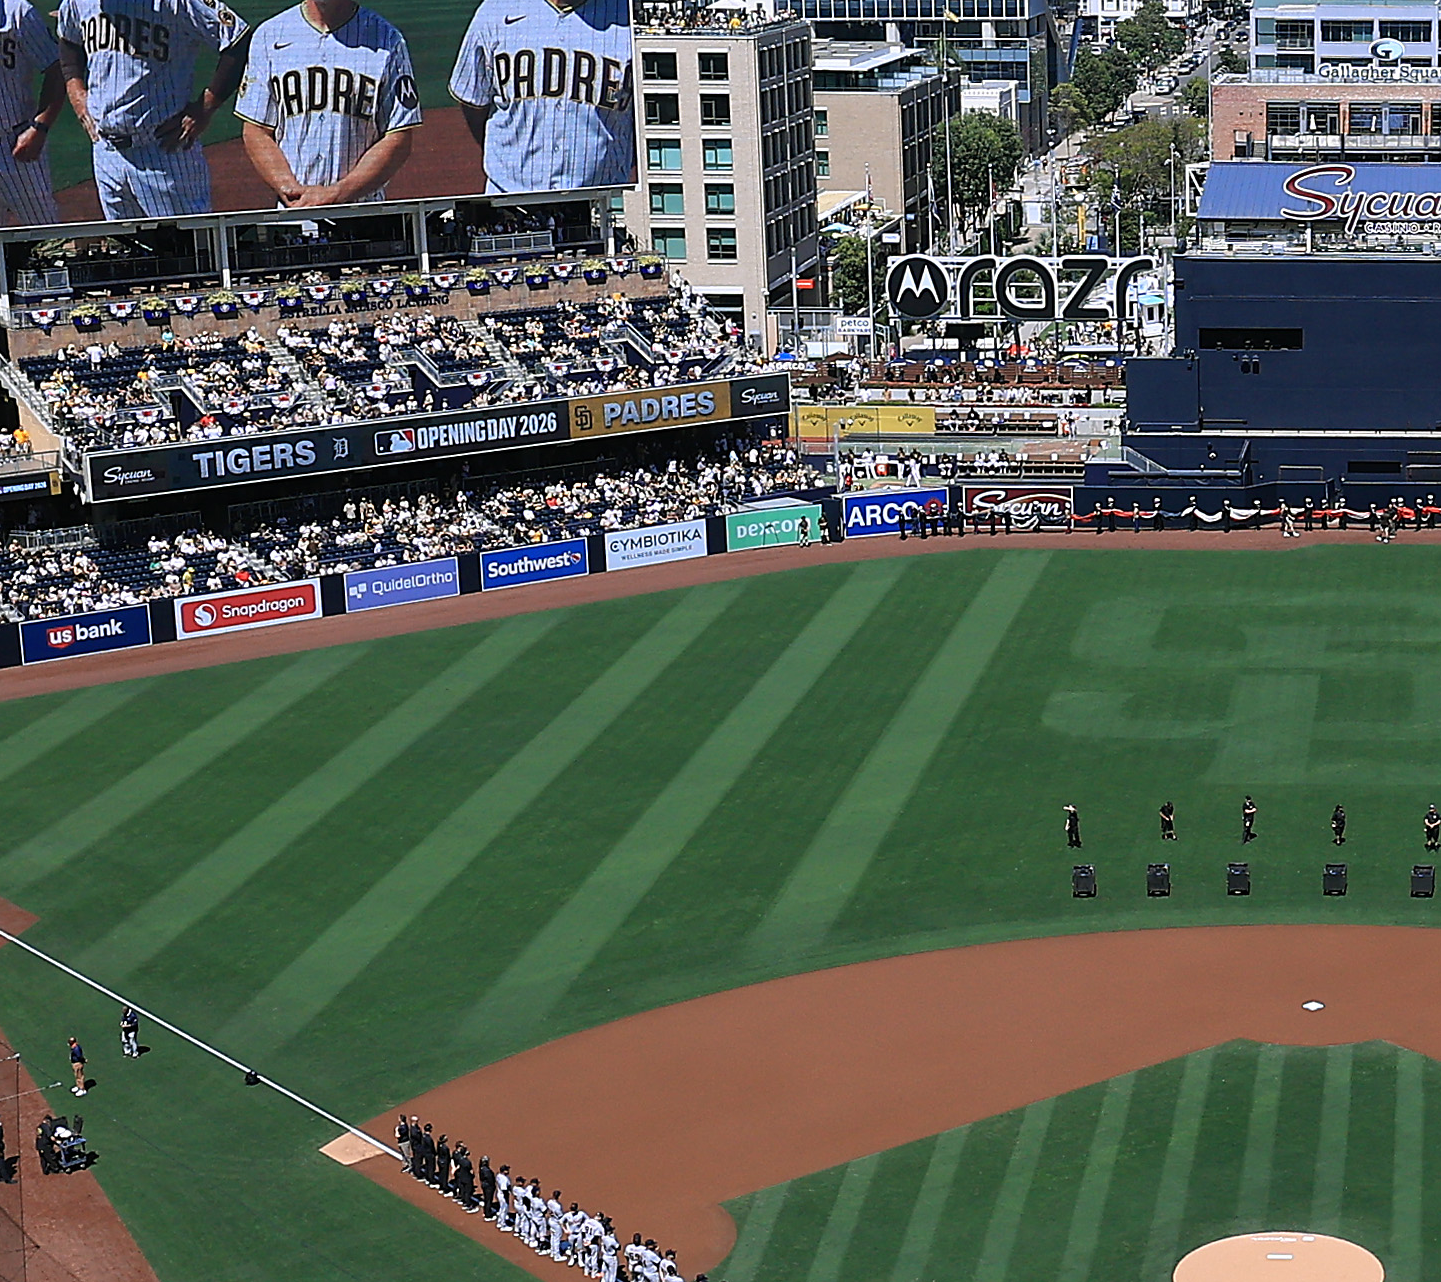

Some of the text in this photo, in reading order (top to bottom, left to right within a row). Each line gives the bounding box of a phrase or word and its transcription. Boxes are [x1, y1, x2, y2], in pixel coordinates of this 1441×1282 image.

[1318, 63, 1395, 82] Gallagher
[1364, 222, 1420, 233] CASINO
[958, 254, 1156, 320] razr
[279, 294, 449, 319] ESTRELLA JALISCO LANDING
[840, 319, 870, 330] petco
[602, 390, 715, 427] PADRES
[741, 388, 778, 405] Sycuan
[418, 412, 557, 450] OPENING DAY 2026
[192, 440, 316, 479] TIGERS
[103, 466, 153, 486] Sycuan
[847, 502, 917, 529] ARCO
[610, 528, 702, 553] CYMBIOTIKA
[487, 552, 571, 578] Southwest
[371, 571, 454, 596] QuidelOrtho
[221, 593, 305, 620] Snapdragon
